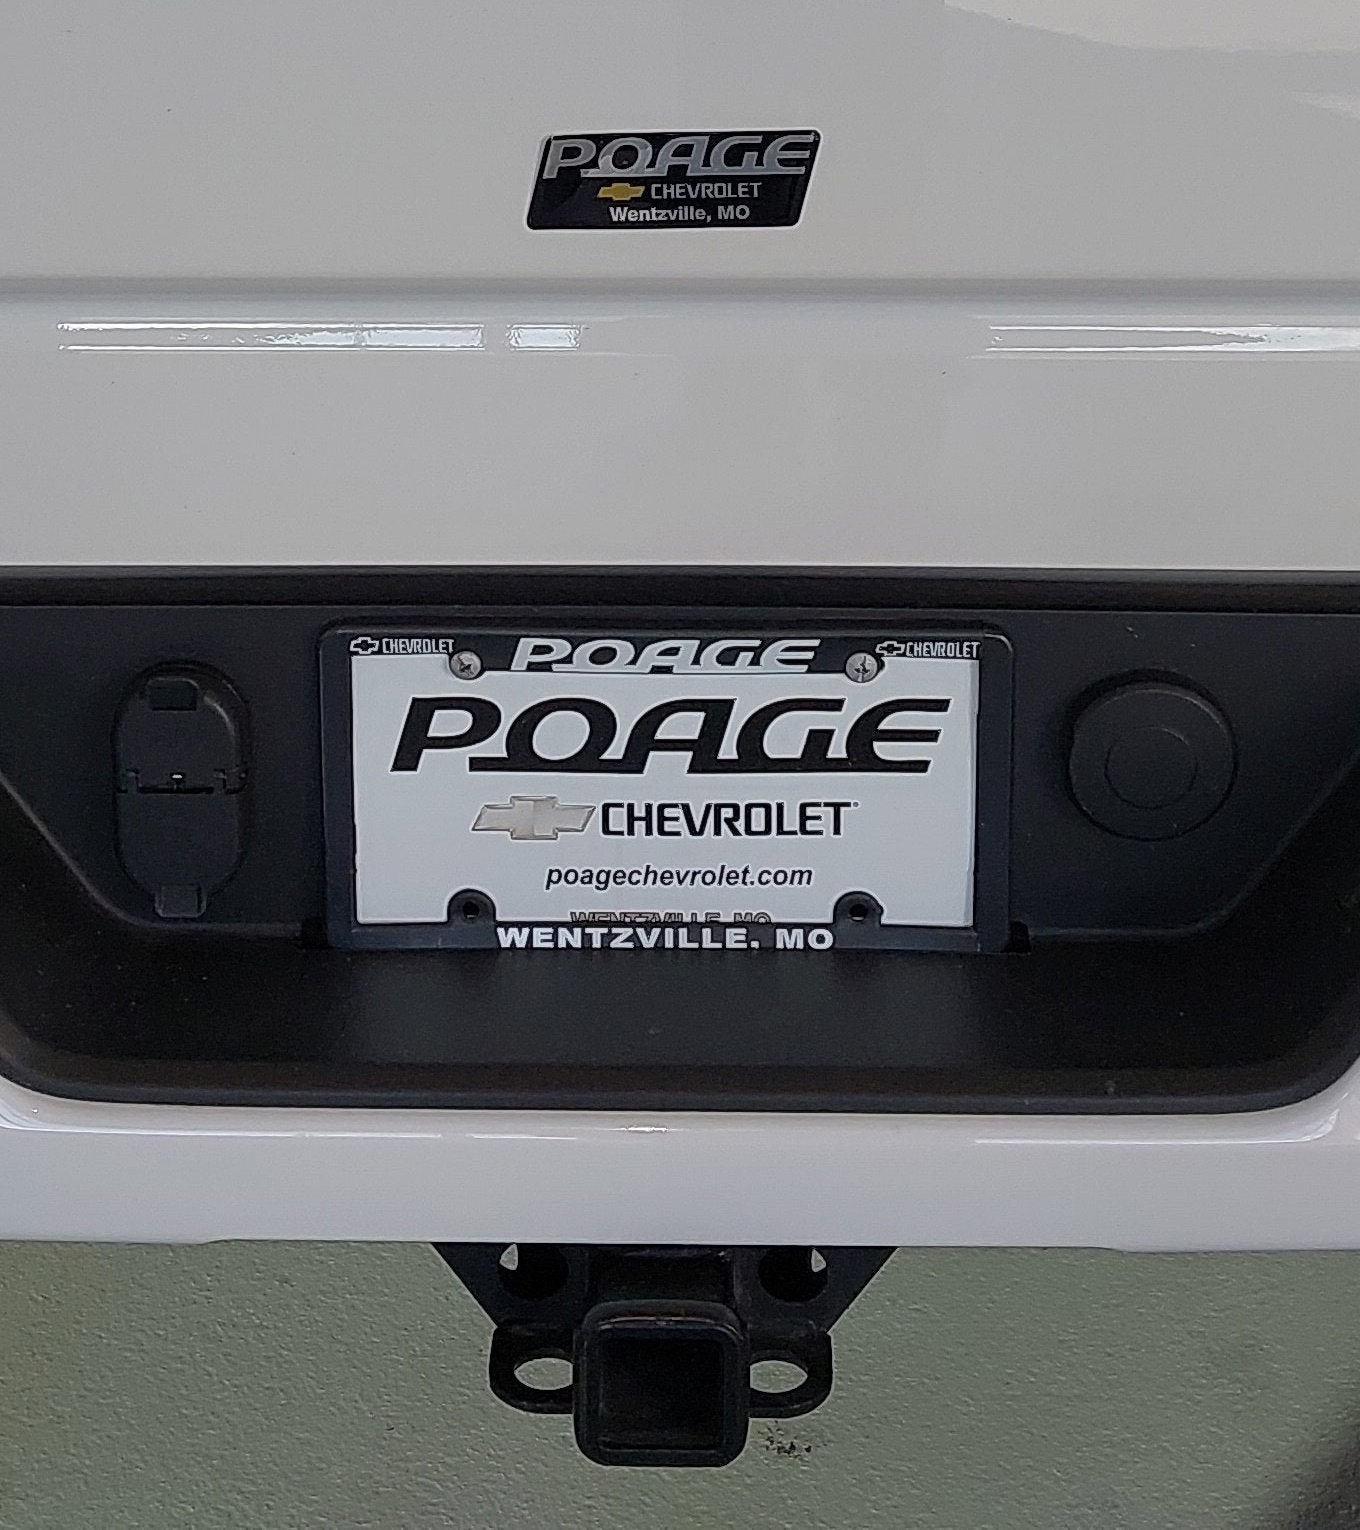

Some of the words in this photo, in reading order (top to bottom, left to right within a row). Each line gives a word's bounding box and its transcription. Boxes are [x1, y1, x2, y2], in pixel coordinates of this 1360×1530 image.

[542, 135, 815, 179] POAGE
[650, 182, 762, 199] CHEVROLET
[609, 206, 711, 222] Wentzville,
[717, 205, 750, 220] MO
[382, 637, 454, 653] CHEVROLET
[510, 637, 821, 672] POAGE
[905, 641, 980, 658] CHEVROLET
[390, 696, 951, 774] POAGE
[601, 801, 852, 837] CHEVROLET
[545, 865, 813, 890] poagechevrolet.com
[775, 928, 834, 950] MO
